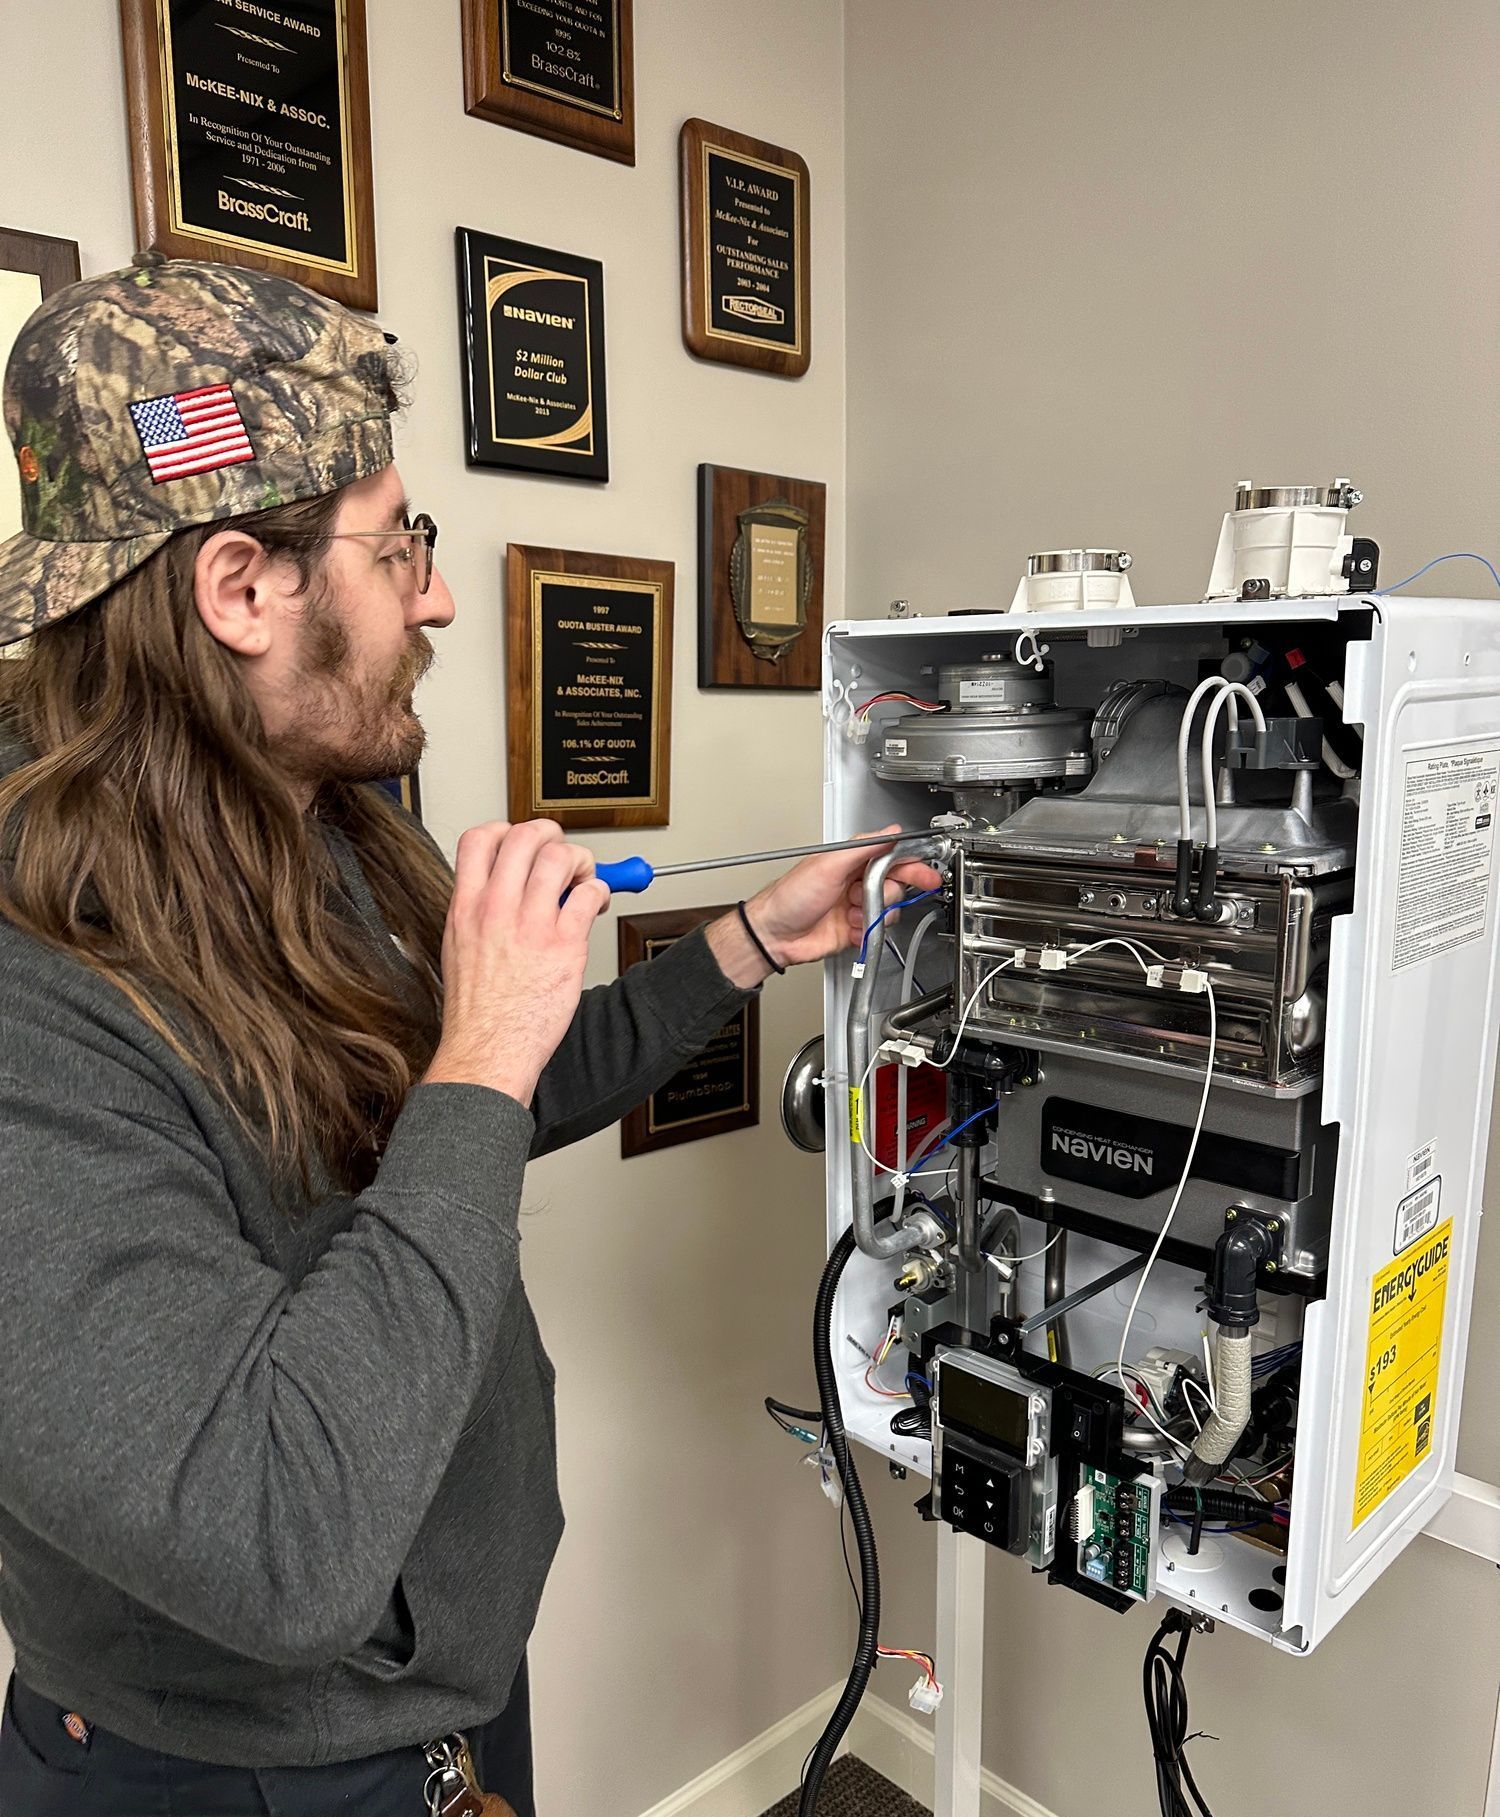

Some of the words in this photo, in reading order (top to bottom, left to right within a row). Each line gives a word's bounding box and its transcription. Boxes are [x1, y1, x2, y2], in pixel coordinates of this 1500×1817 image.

[235, 0, 281, 24] SERVICE
[283, 17, 321, 38] AWARD
[517, 0, 554, 18] EXCEEDING
[555, 12, 573, 26] YOUR
[574, 21, 598, 35] QUOTA
[599, 30, 606, 38] IN
[574, 6, 588, 16] AND
[237, 53, 270, 72] Presented
[270, 64, 280, 74] To
[186, 73, 264, 109] McKEE-NIX
[267, 99, 277, 112] &
[280, 104, 331, 129] ASSOC.
[189, 113, 198, 124] In
[201, 116, 249, 139] Recognition
[251, 130, 262, 142] Of
[263, 133, 283, 150] Your
[284, 142, 331, 165] Outstanding
[206, 131, 236, 150] Service
[237, 141, 252, 153] and
[254, 145, 297, 166] Dedication
[298, 158, 317, 171] from
[241, 154, 260, 168] 1971
[267, 160, 286, 175] 2006
[725, 175, 746, 192] V.I.P.
[747, 184, 779, 201] AWARD
[734, 197, 763, 214] Presented
[715, 209, 750, 227] McKee-Nix
[751, 220, 757, 229] &
[747, 236, 758, 246] For
[716, 244, 766, 265] OUTSTANDING
[768, 258, 789, 271] SALES
[727, 258, 779, 279] PERFORMANCE
[516, 349, 528, 362] $2
[530, 352, 564, 368] Million
[514, 366, 544, 380] Dollar
[546, 371, 567, 385] Club
[506, 392, 539, 404] McKee-Nix
[546, 398, 576, 410] Associates
[558, 620, 585, 630] QUOTA
[586, 622, 615, 632] BUSTER
[616, 625, 642, 634] AWARD
[577, 674, 624, 685] McKEE-NIX
[557, 686, 563, 695] &
[566, 687, 623, 698] ASSOCIATES,
[624, 689, 642, 698] INC.
[593, 739, 605, 748] OF
[607, 739, 636, 748] QUOTA
[1052, 1126, 1093, 1140] CONDENSING
[1094, 1136, 1111, 1144] HEAT
[1113, 1141, 1153, 1154] EXCHANGER
[955, 1463, 964, 1475] M
[953, 1505, 964, 1519] OK
